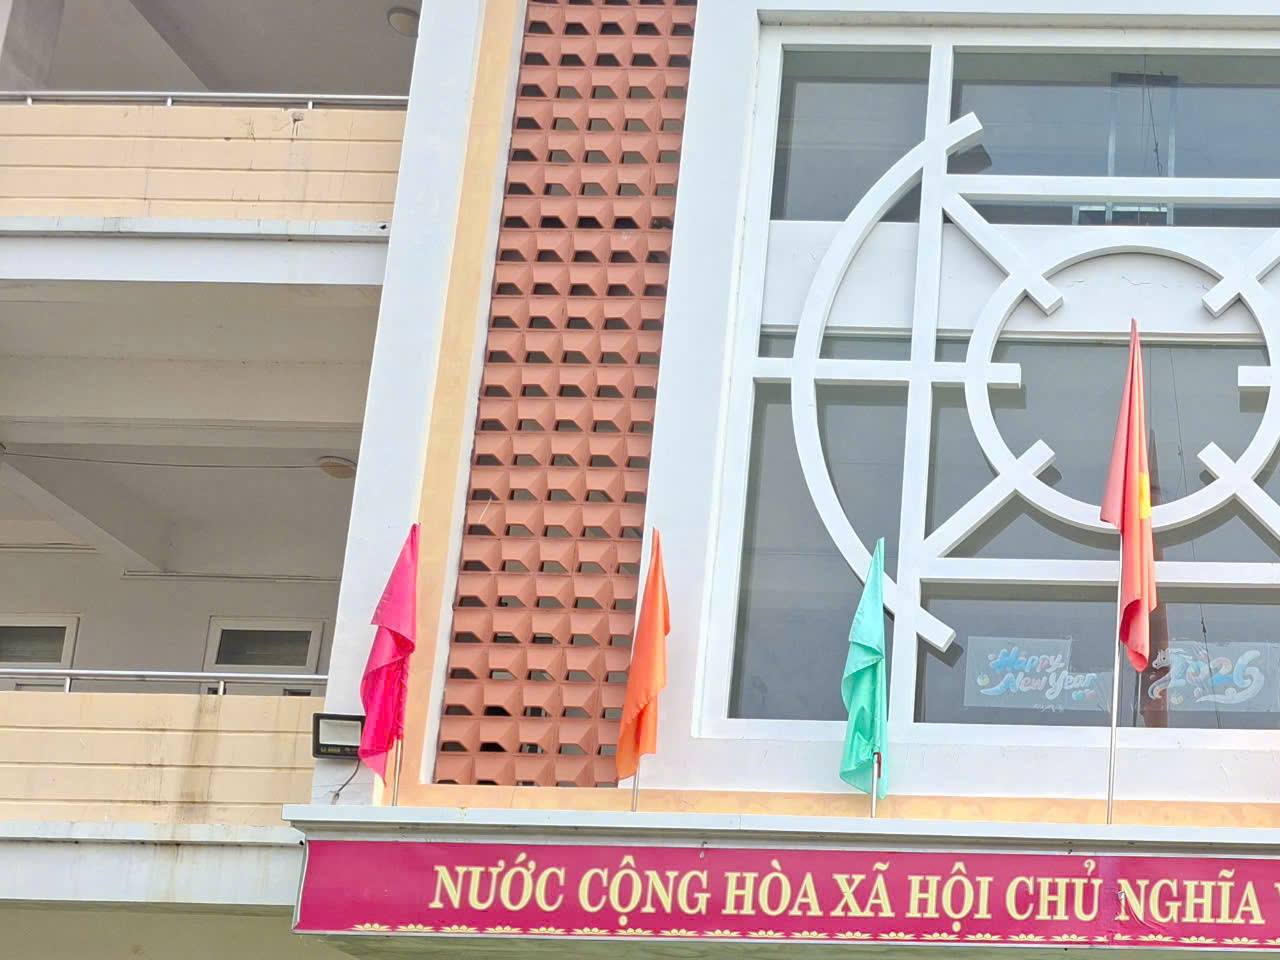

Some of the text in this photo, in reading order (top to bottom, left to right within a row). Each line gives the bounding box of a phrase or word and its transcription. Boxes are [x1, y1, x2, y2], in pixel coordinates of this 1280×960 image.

[988, 646, 1065, 672] Happy
[980, 670, 1098, 700] New Year
[429, 853, 565, 911] NƯỚC
[578, 855, 711, 926] CỘNG
[722, 859, 823, 917] HÒA
[830, 861, 896, 917] XÃ
[905, 861, 994, 932] HỘI
[1005, 859, 1103, 921] CHỦ
[1115, 868, 1265, 925] NGHĨA
